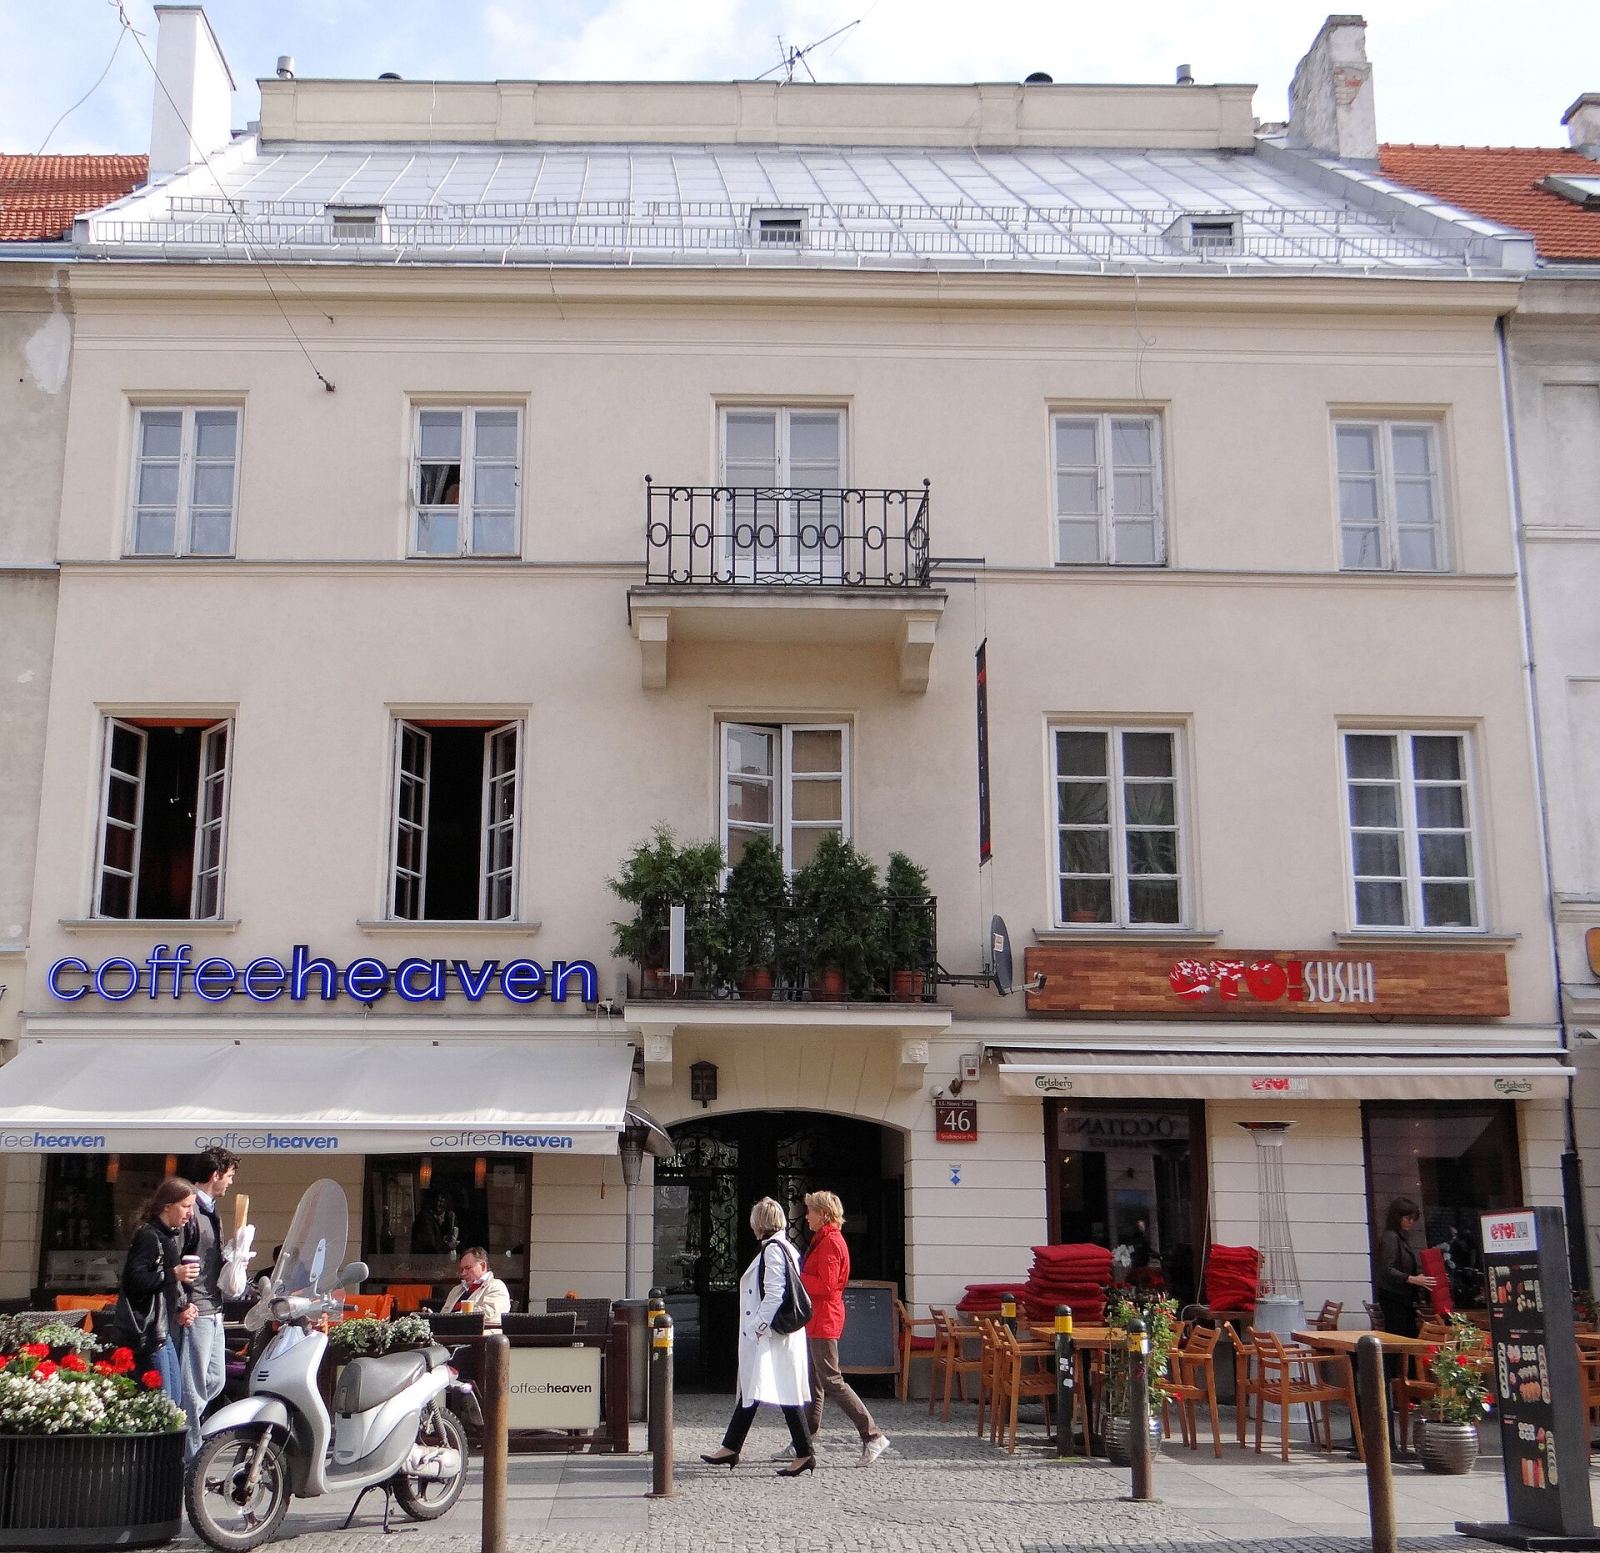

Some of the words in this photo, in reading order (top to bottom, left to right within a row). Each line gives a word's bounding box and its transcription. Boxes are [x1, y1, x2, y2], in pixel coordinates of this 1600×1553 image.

[48, 944, 599, 1003] coffeeheaven
[1035, 1075, 1073, 1091] Carlsberg
[1494, 1078, 1532, 1093] Carlsberg
[943, 1110, 971, 1131] 46
[195, 1132, 339, 1149] coffeeheaven
[429, 1131, 572, 1148] coffeeheaven
[510, 1382, 592, 1394] offeeheaven
